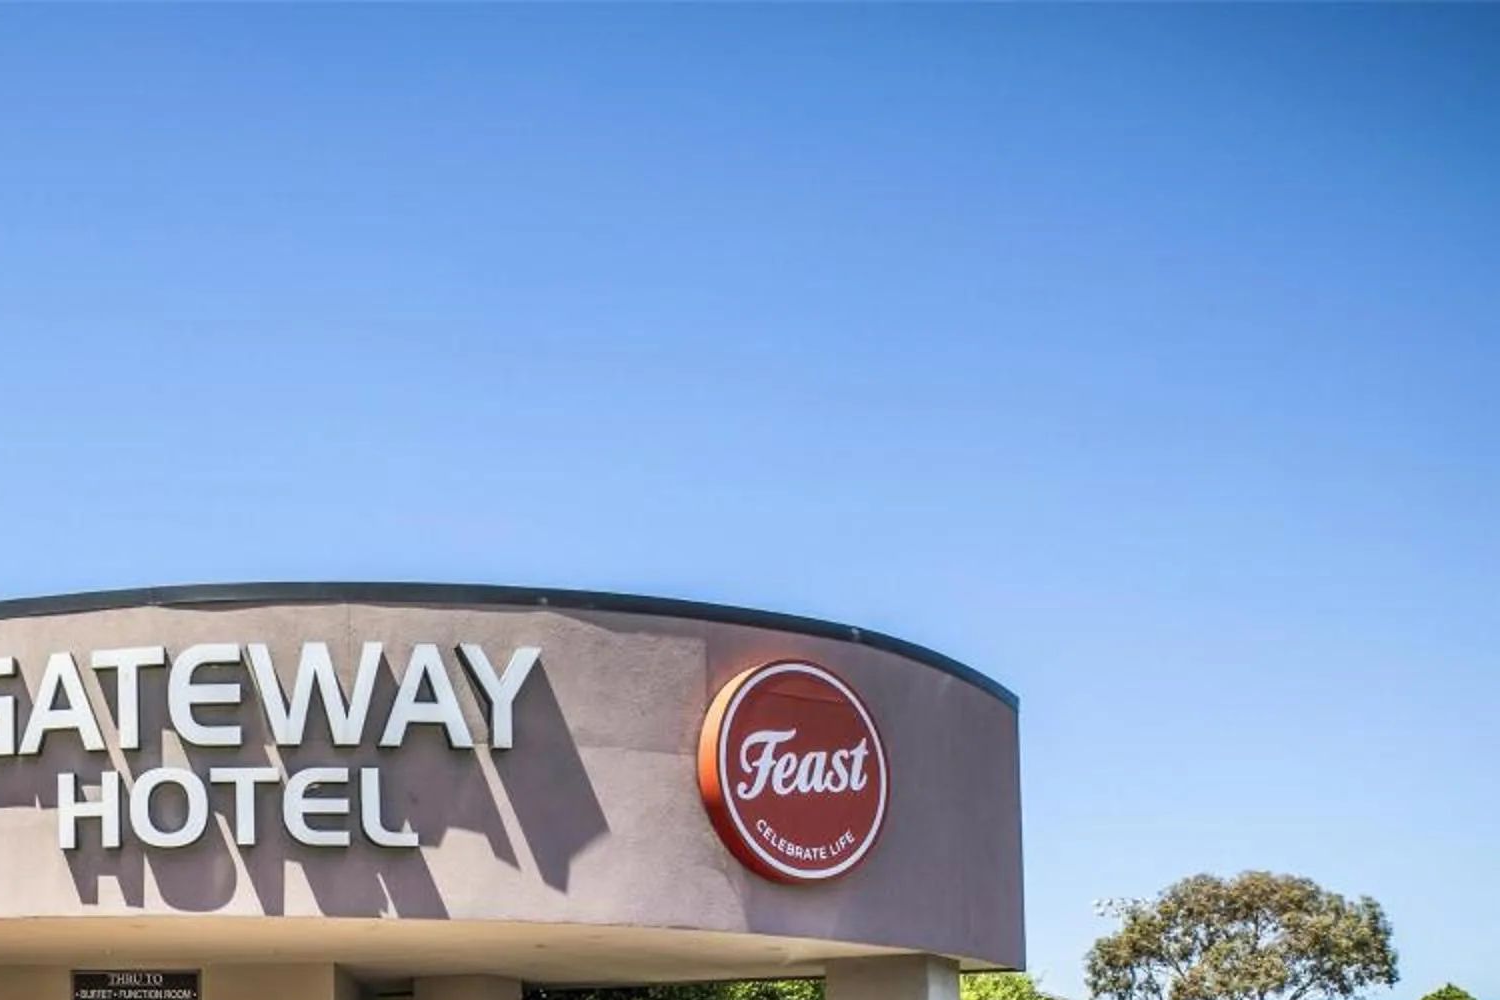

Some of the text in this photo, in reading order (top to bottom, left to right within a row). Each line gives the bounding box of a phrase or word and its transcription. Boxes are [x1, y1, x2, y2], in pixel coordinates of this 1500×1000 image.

[737, 728, 868, 800] Feast
[58, 766, 419, 851] HOTEL
[756, 819, 856, 861] CELEBRATE LIFE
[80, 989, 192, 1000] BUFFET FUNCTION ROOM
